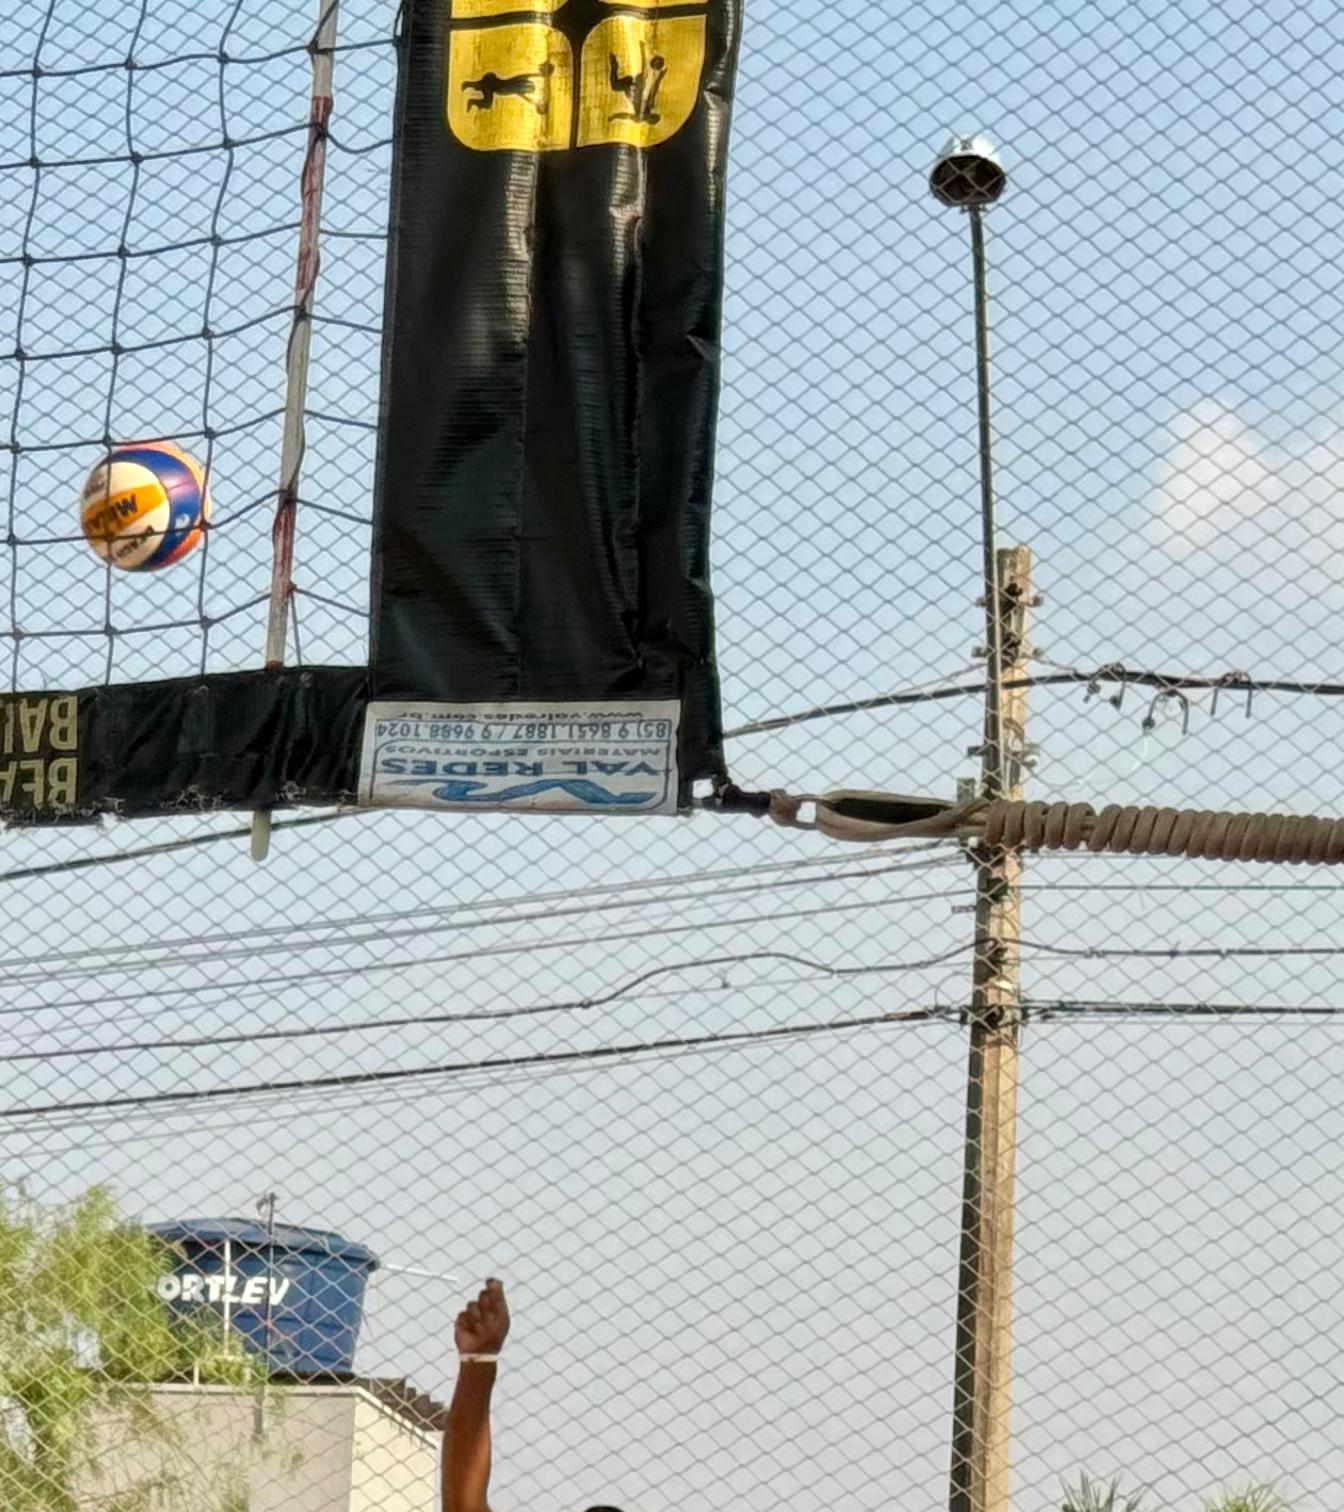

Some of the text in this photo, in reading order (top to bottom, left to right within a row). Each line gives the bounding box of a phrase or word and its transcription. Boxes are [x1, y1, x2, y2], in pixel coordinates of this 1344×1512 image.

[480, 722, 493, 740] 9
[617, 721, 630, 739] 9
[380, 758, 660, 777] VAL REDES
[157, 1273, 290, 1306] ORTLEV
